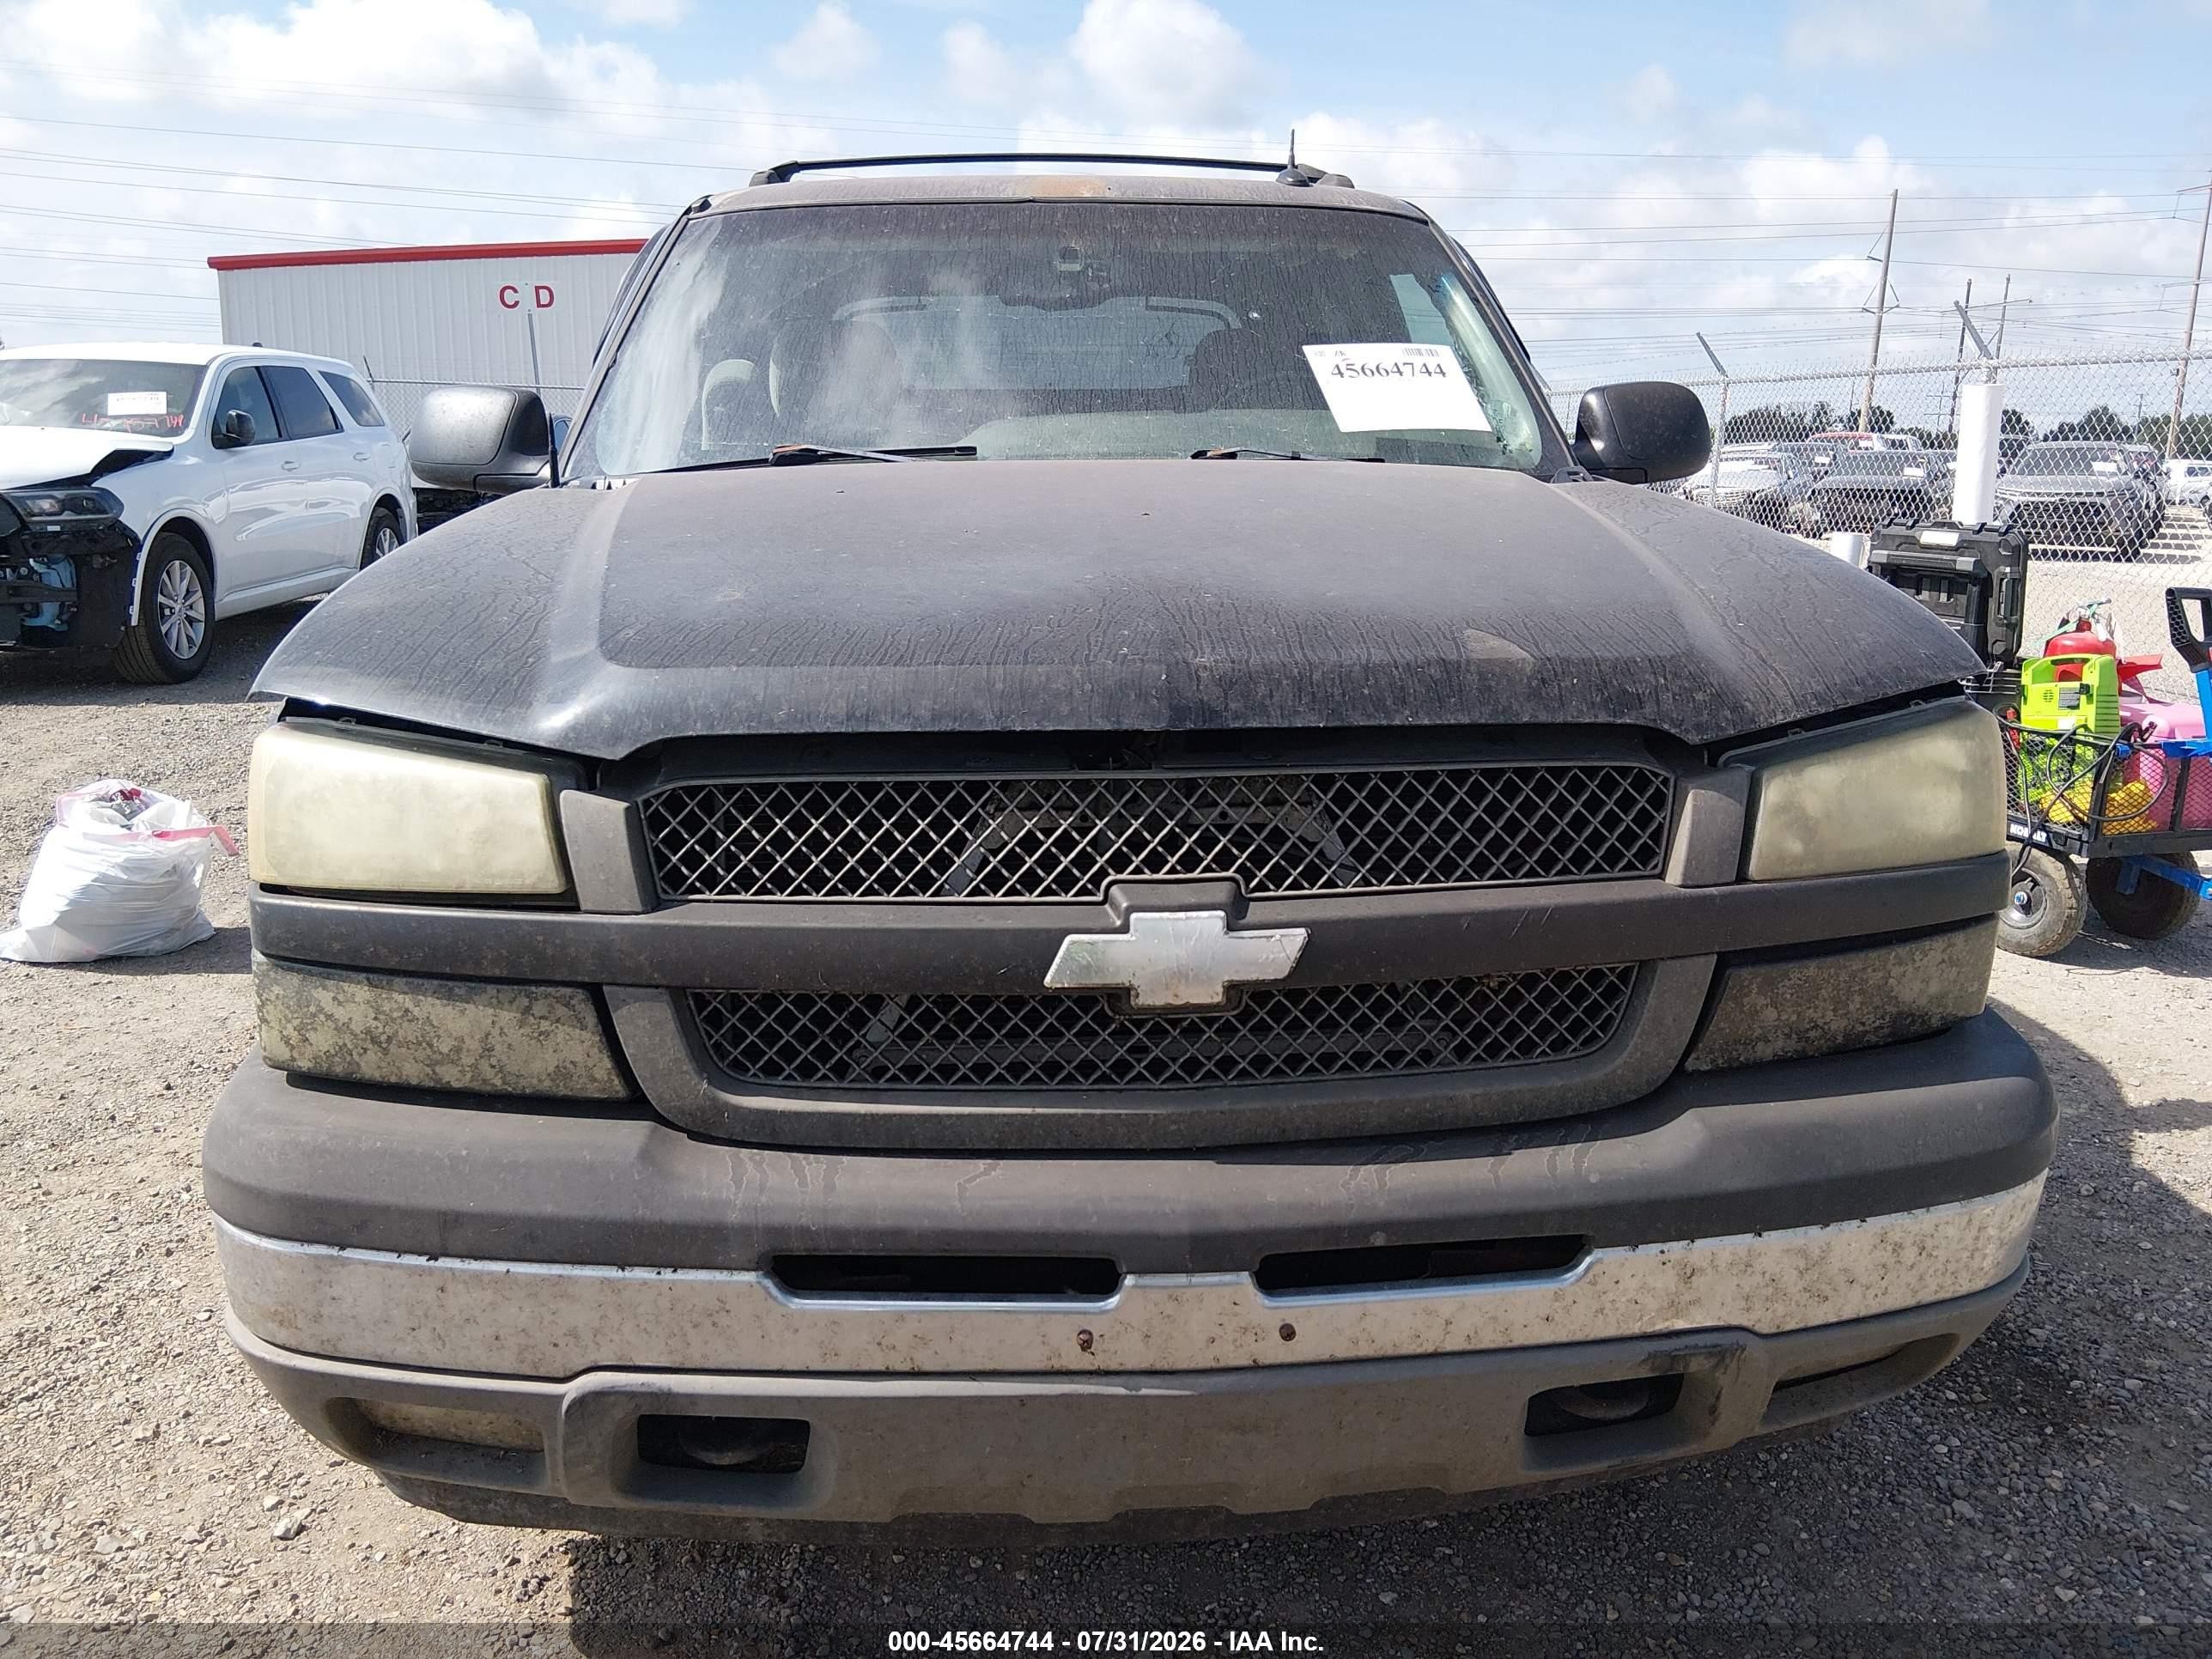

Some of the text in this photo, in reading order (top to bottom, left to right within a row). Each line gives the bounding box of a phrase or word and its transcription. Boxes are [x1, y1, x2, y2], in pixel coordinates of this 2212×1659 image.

[499, 285, 555, 309] C D
[1331, 362, 1447, 379] 45664744
